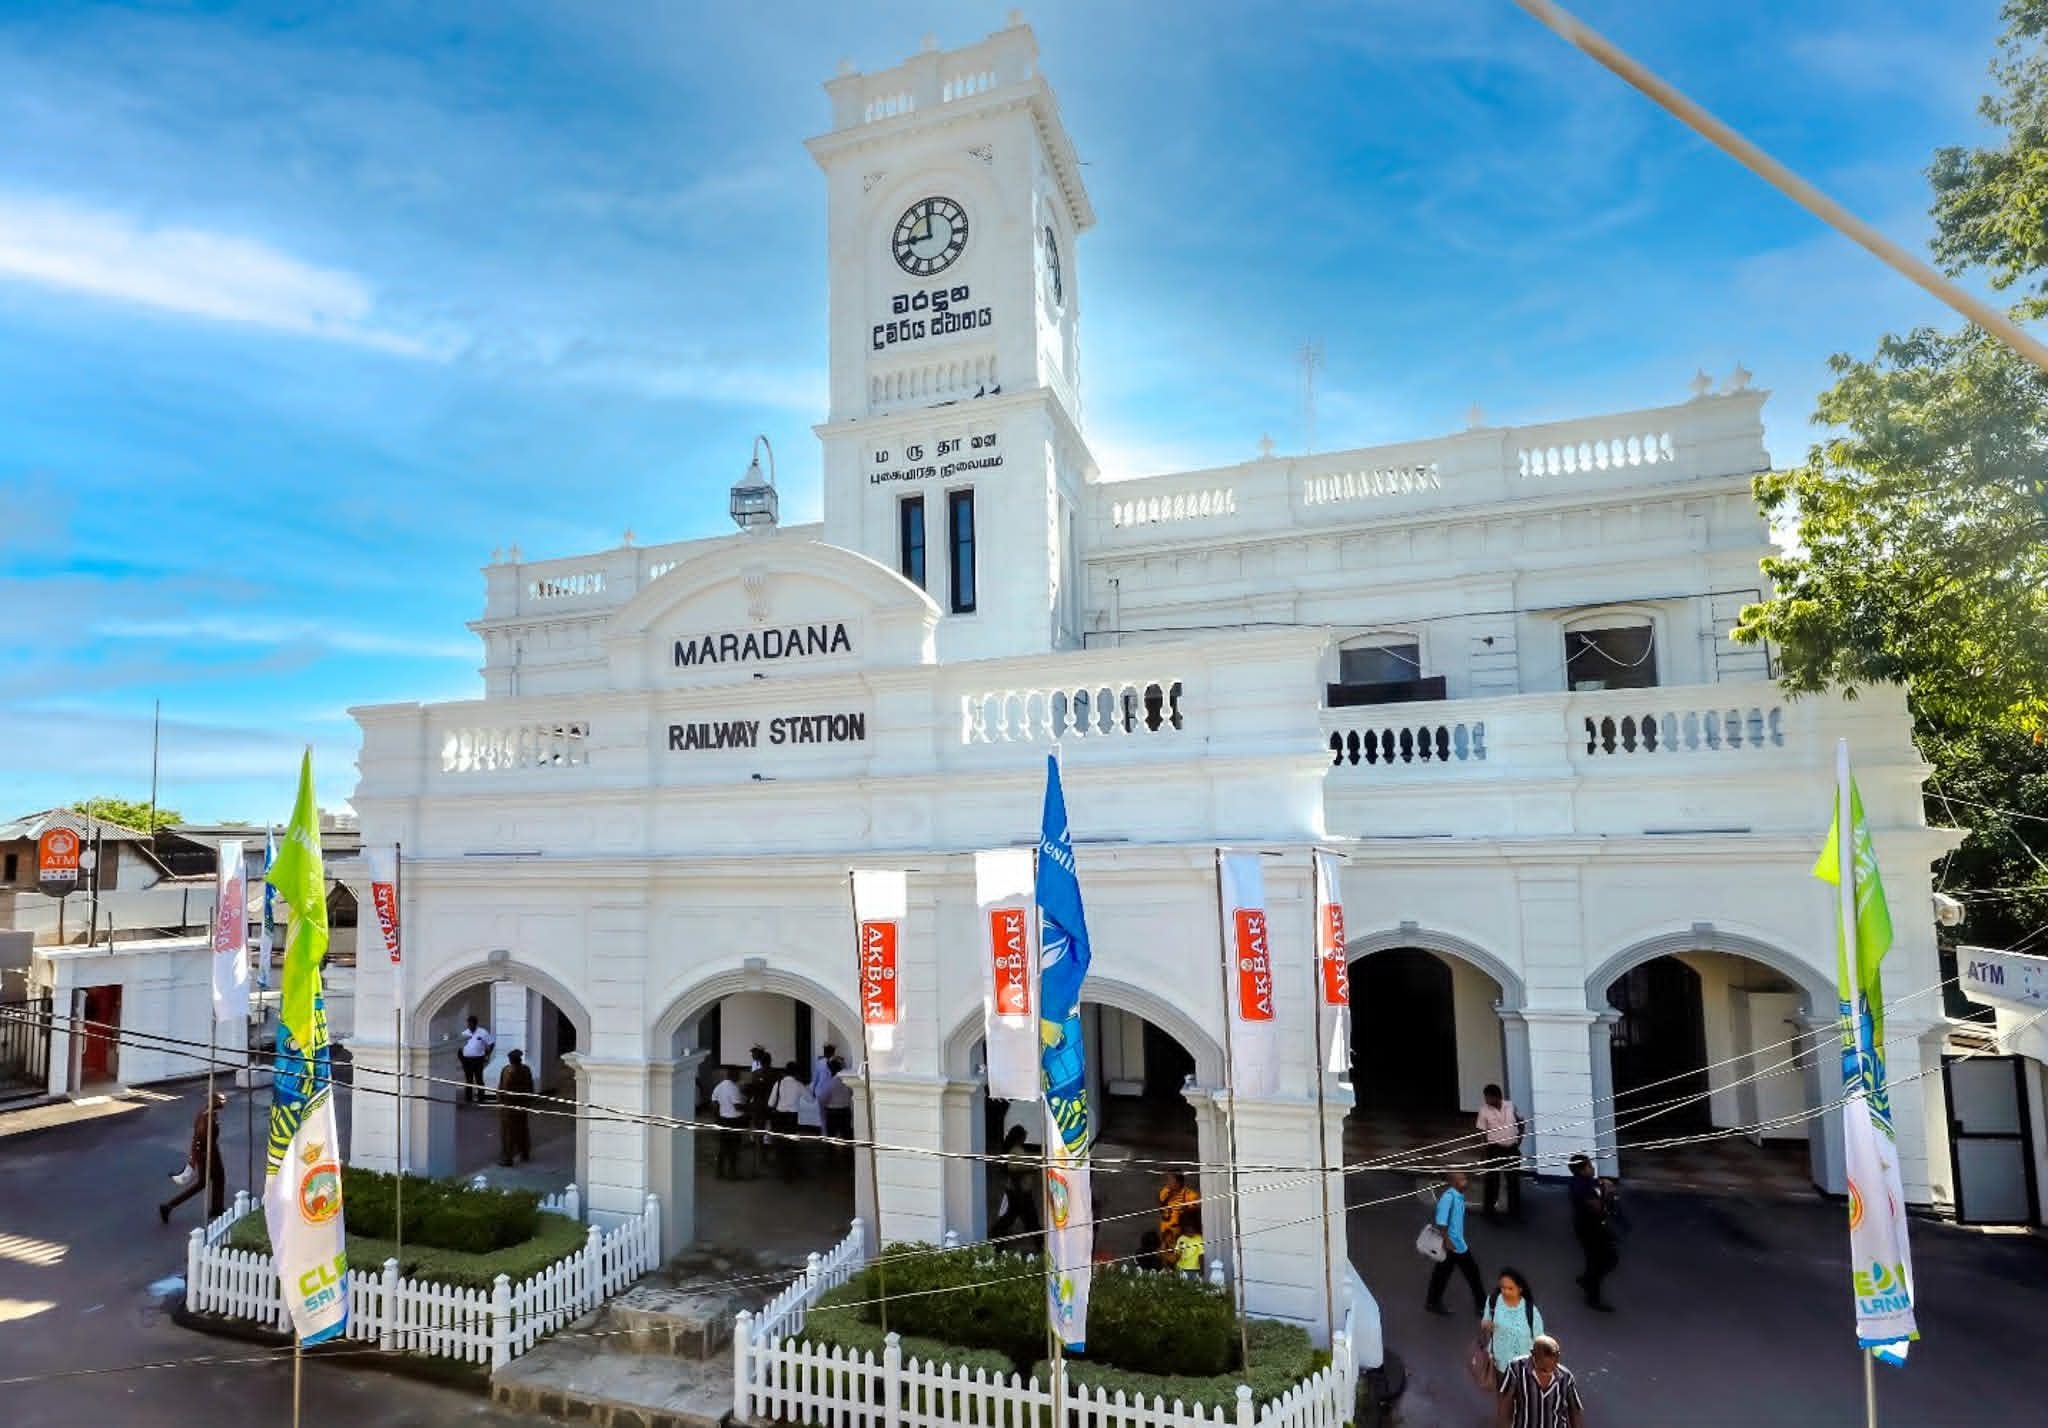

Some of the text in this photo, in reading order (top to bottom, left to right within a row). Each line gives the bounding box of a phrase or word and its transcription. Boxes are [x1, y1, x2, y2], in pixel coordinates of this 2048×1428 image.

[674, 623, 851, 667] MARADANA
[668, 712, 865, 751] RAILWAY STATION
[46, 855, 76, 865] ATM
[867, 927, 884, 1018] AKBAR
[1006, 914, 1025, 1009] AKBAR
[1247, 917, 1271, 1014] AKBAR
[1331, 911, 1349, 998] AKBAR
[1967, 960, 2005, 985] ATM
